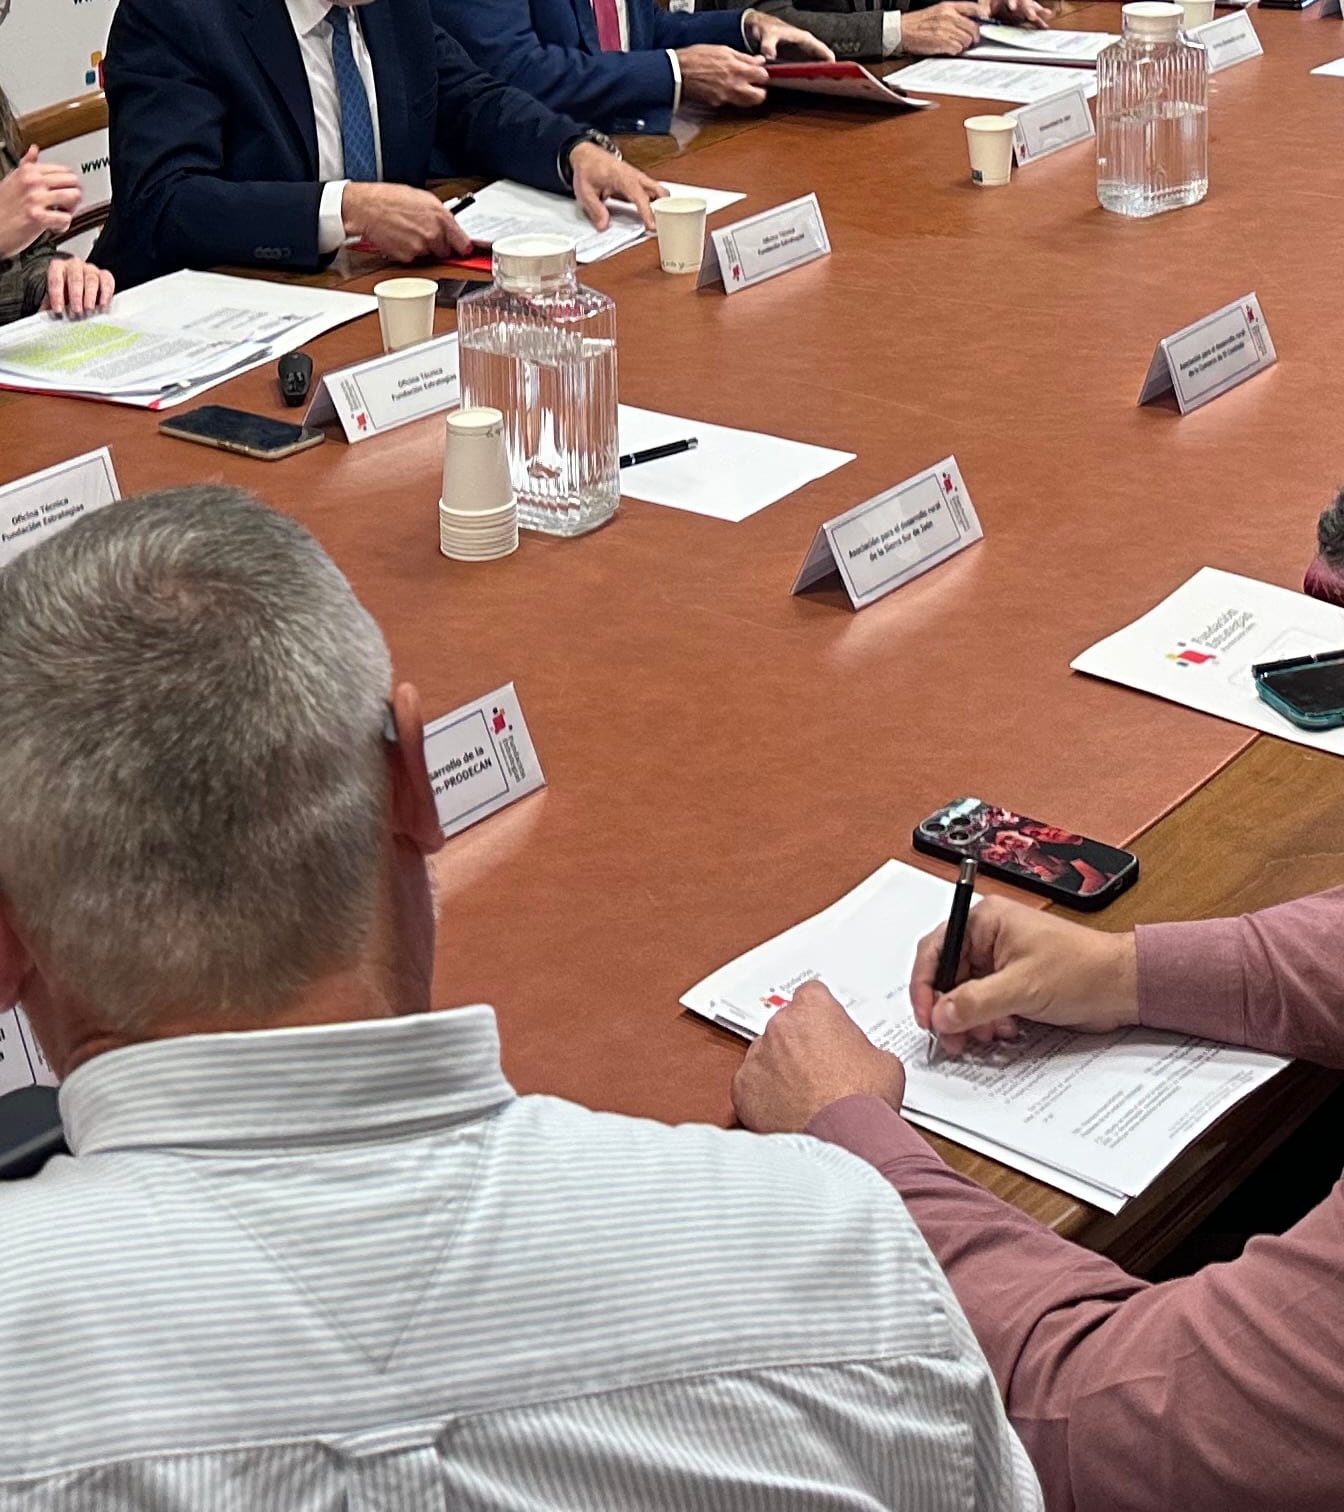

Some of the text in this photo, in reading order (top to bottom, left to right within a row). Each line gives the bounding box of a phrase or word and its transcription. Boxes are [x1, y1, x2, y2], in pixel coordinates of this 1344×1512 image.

[1, 503, 84, 542] Fundación Estrategias
[11, 496, 68, 526] Oficina Técnica
[848, 536, 880, 559] Asociación
[429, 746, 485, 780] sarrollo de la
[434, 757, 493, 796] n-PRODECAN
